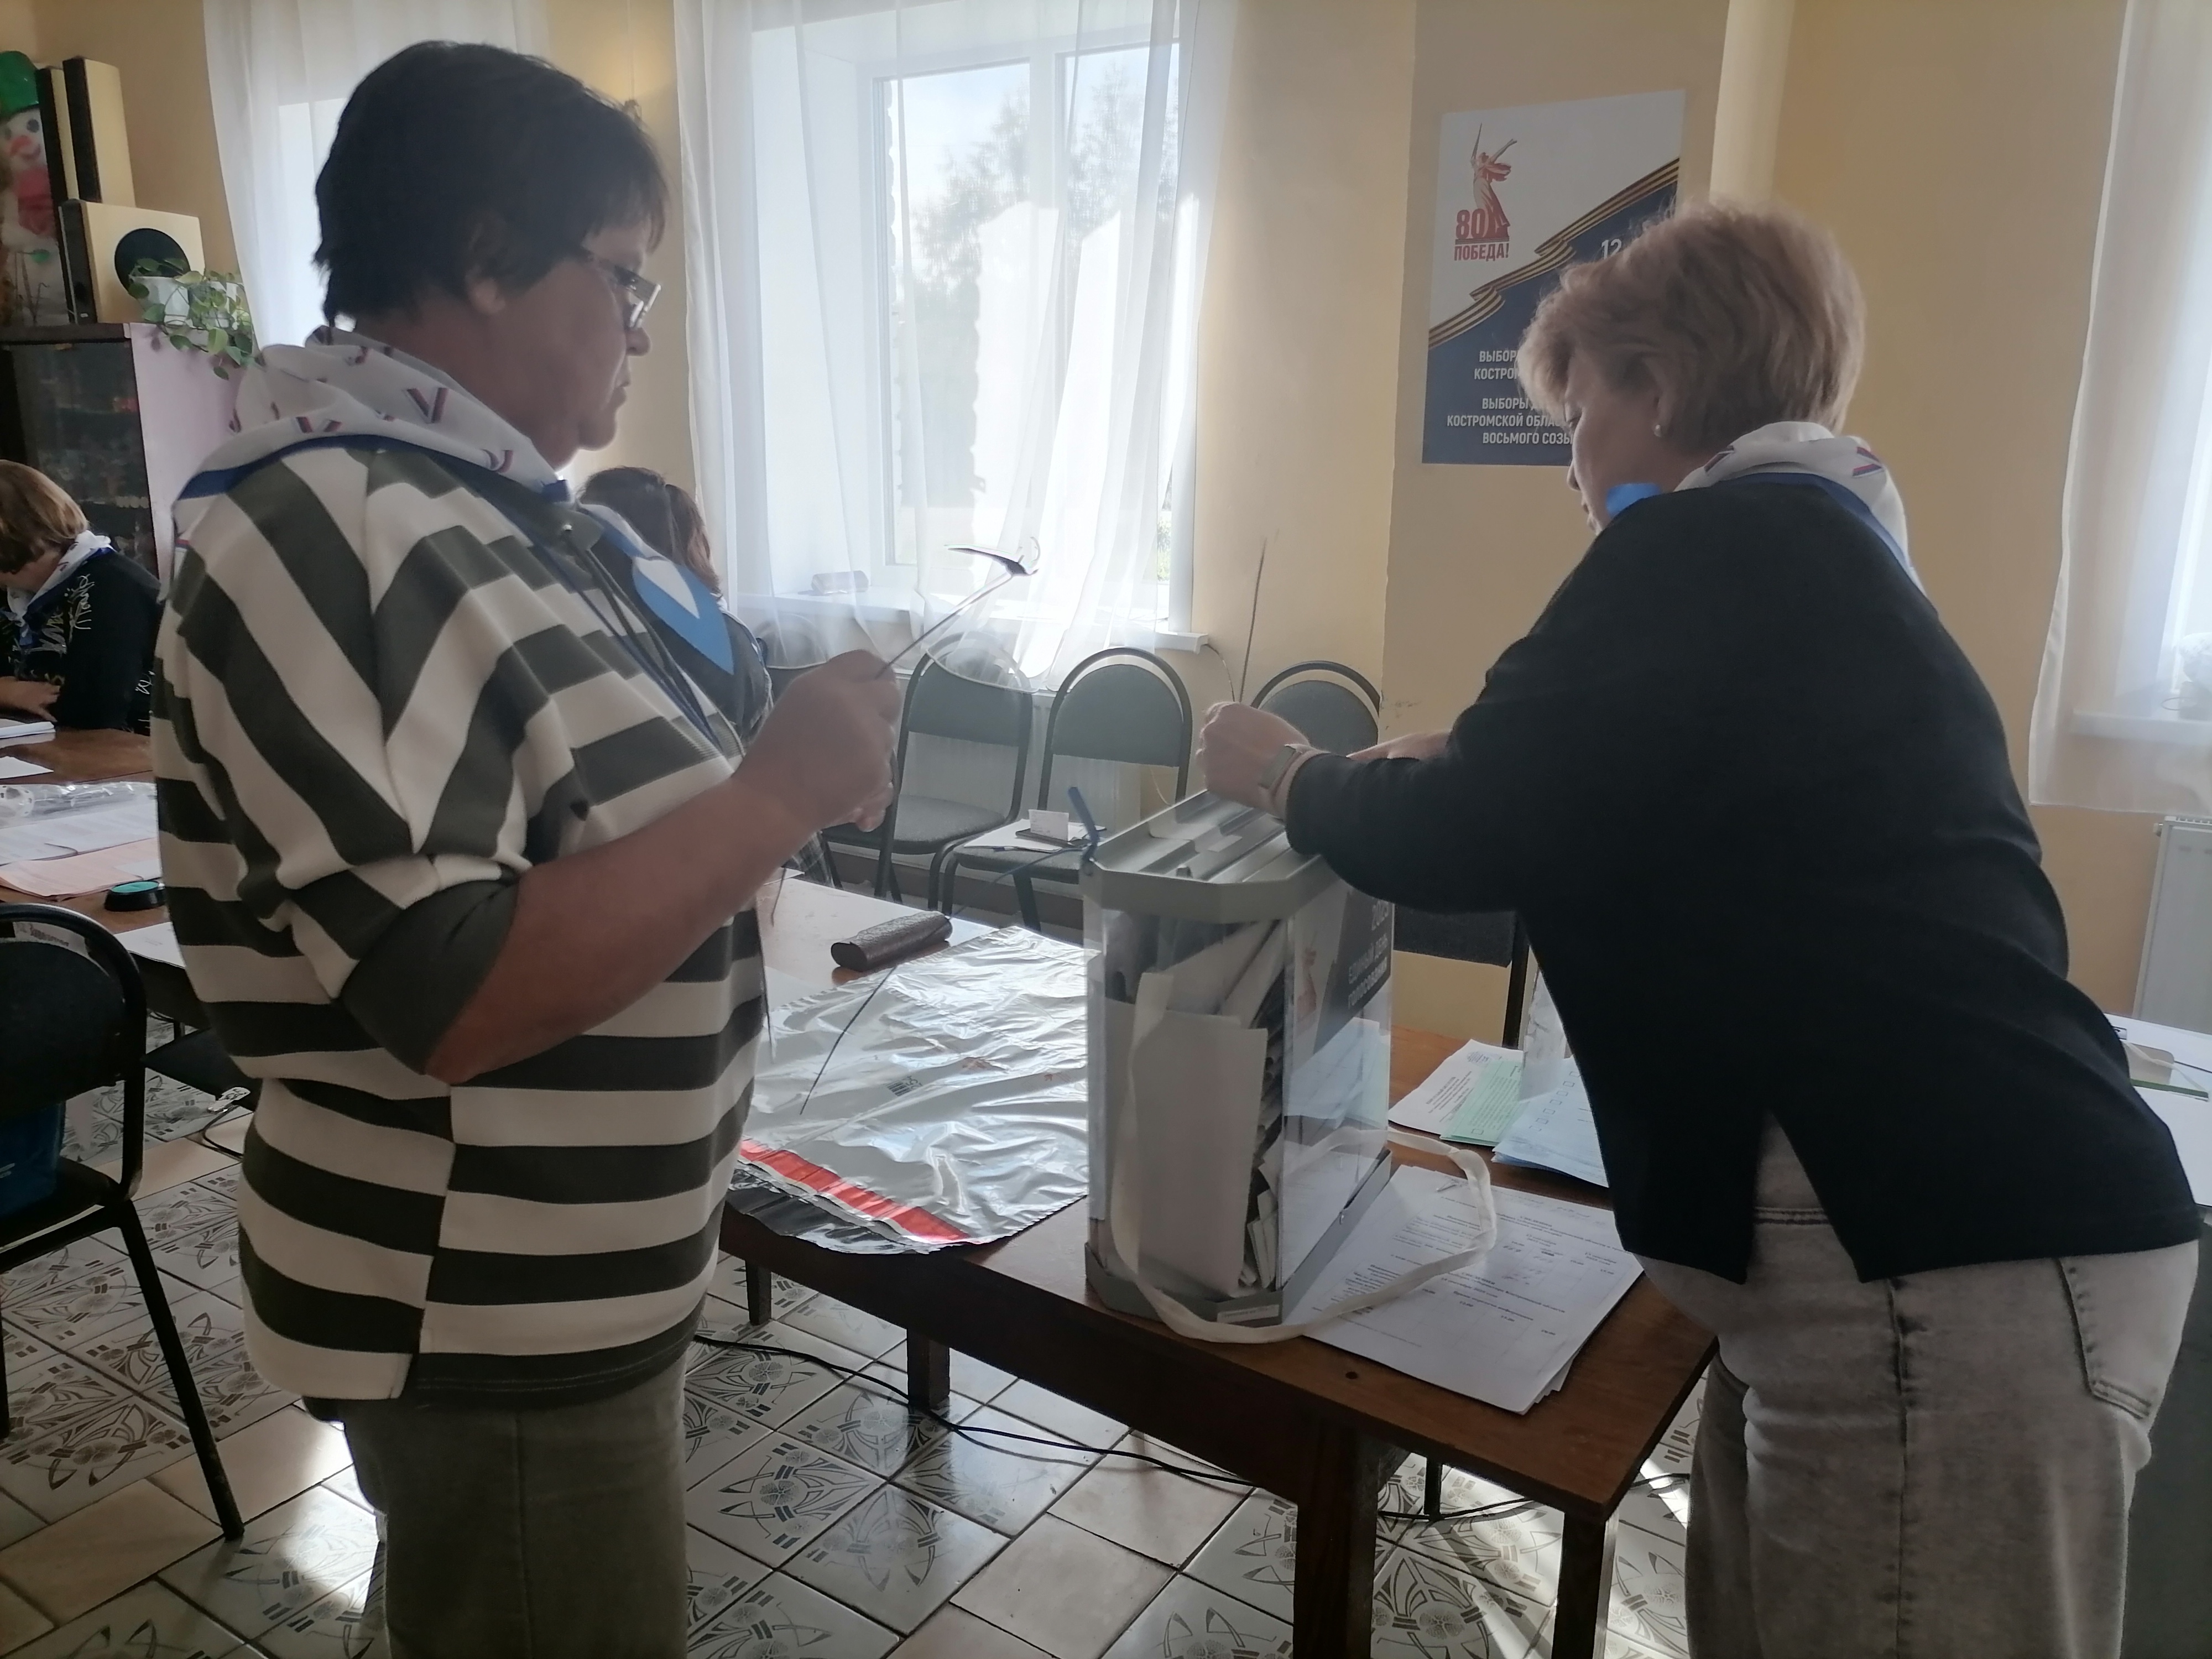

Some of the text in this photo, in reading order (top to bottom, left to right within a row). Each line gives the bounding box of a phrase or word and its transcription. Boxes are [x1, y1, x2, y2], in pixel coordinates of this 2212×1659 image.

[1456, 208, 1485, 238] 80
[1454, 243, 1509, 262] ПОБЕДА!
[1482, 398, 1529, 409] ВЫБОРЫ
[1447, 413, 1523, 426] КОСТРОМСКОЙ
[1483, 432, 1539, 444] ВОСЬМОГО
